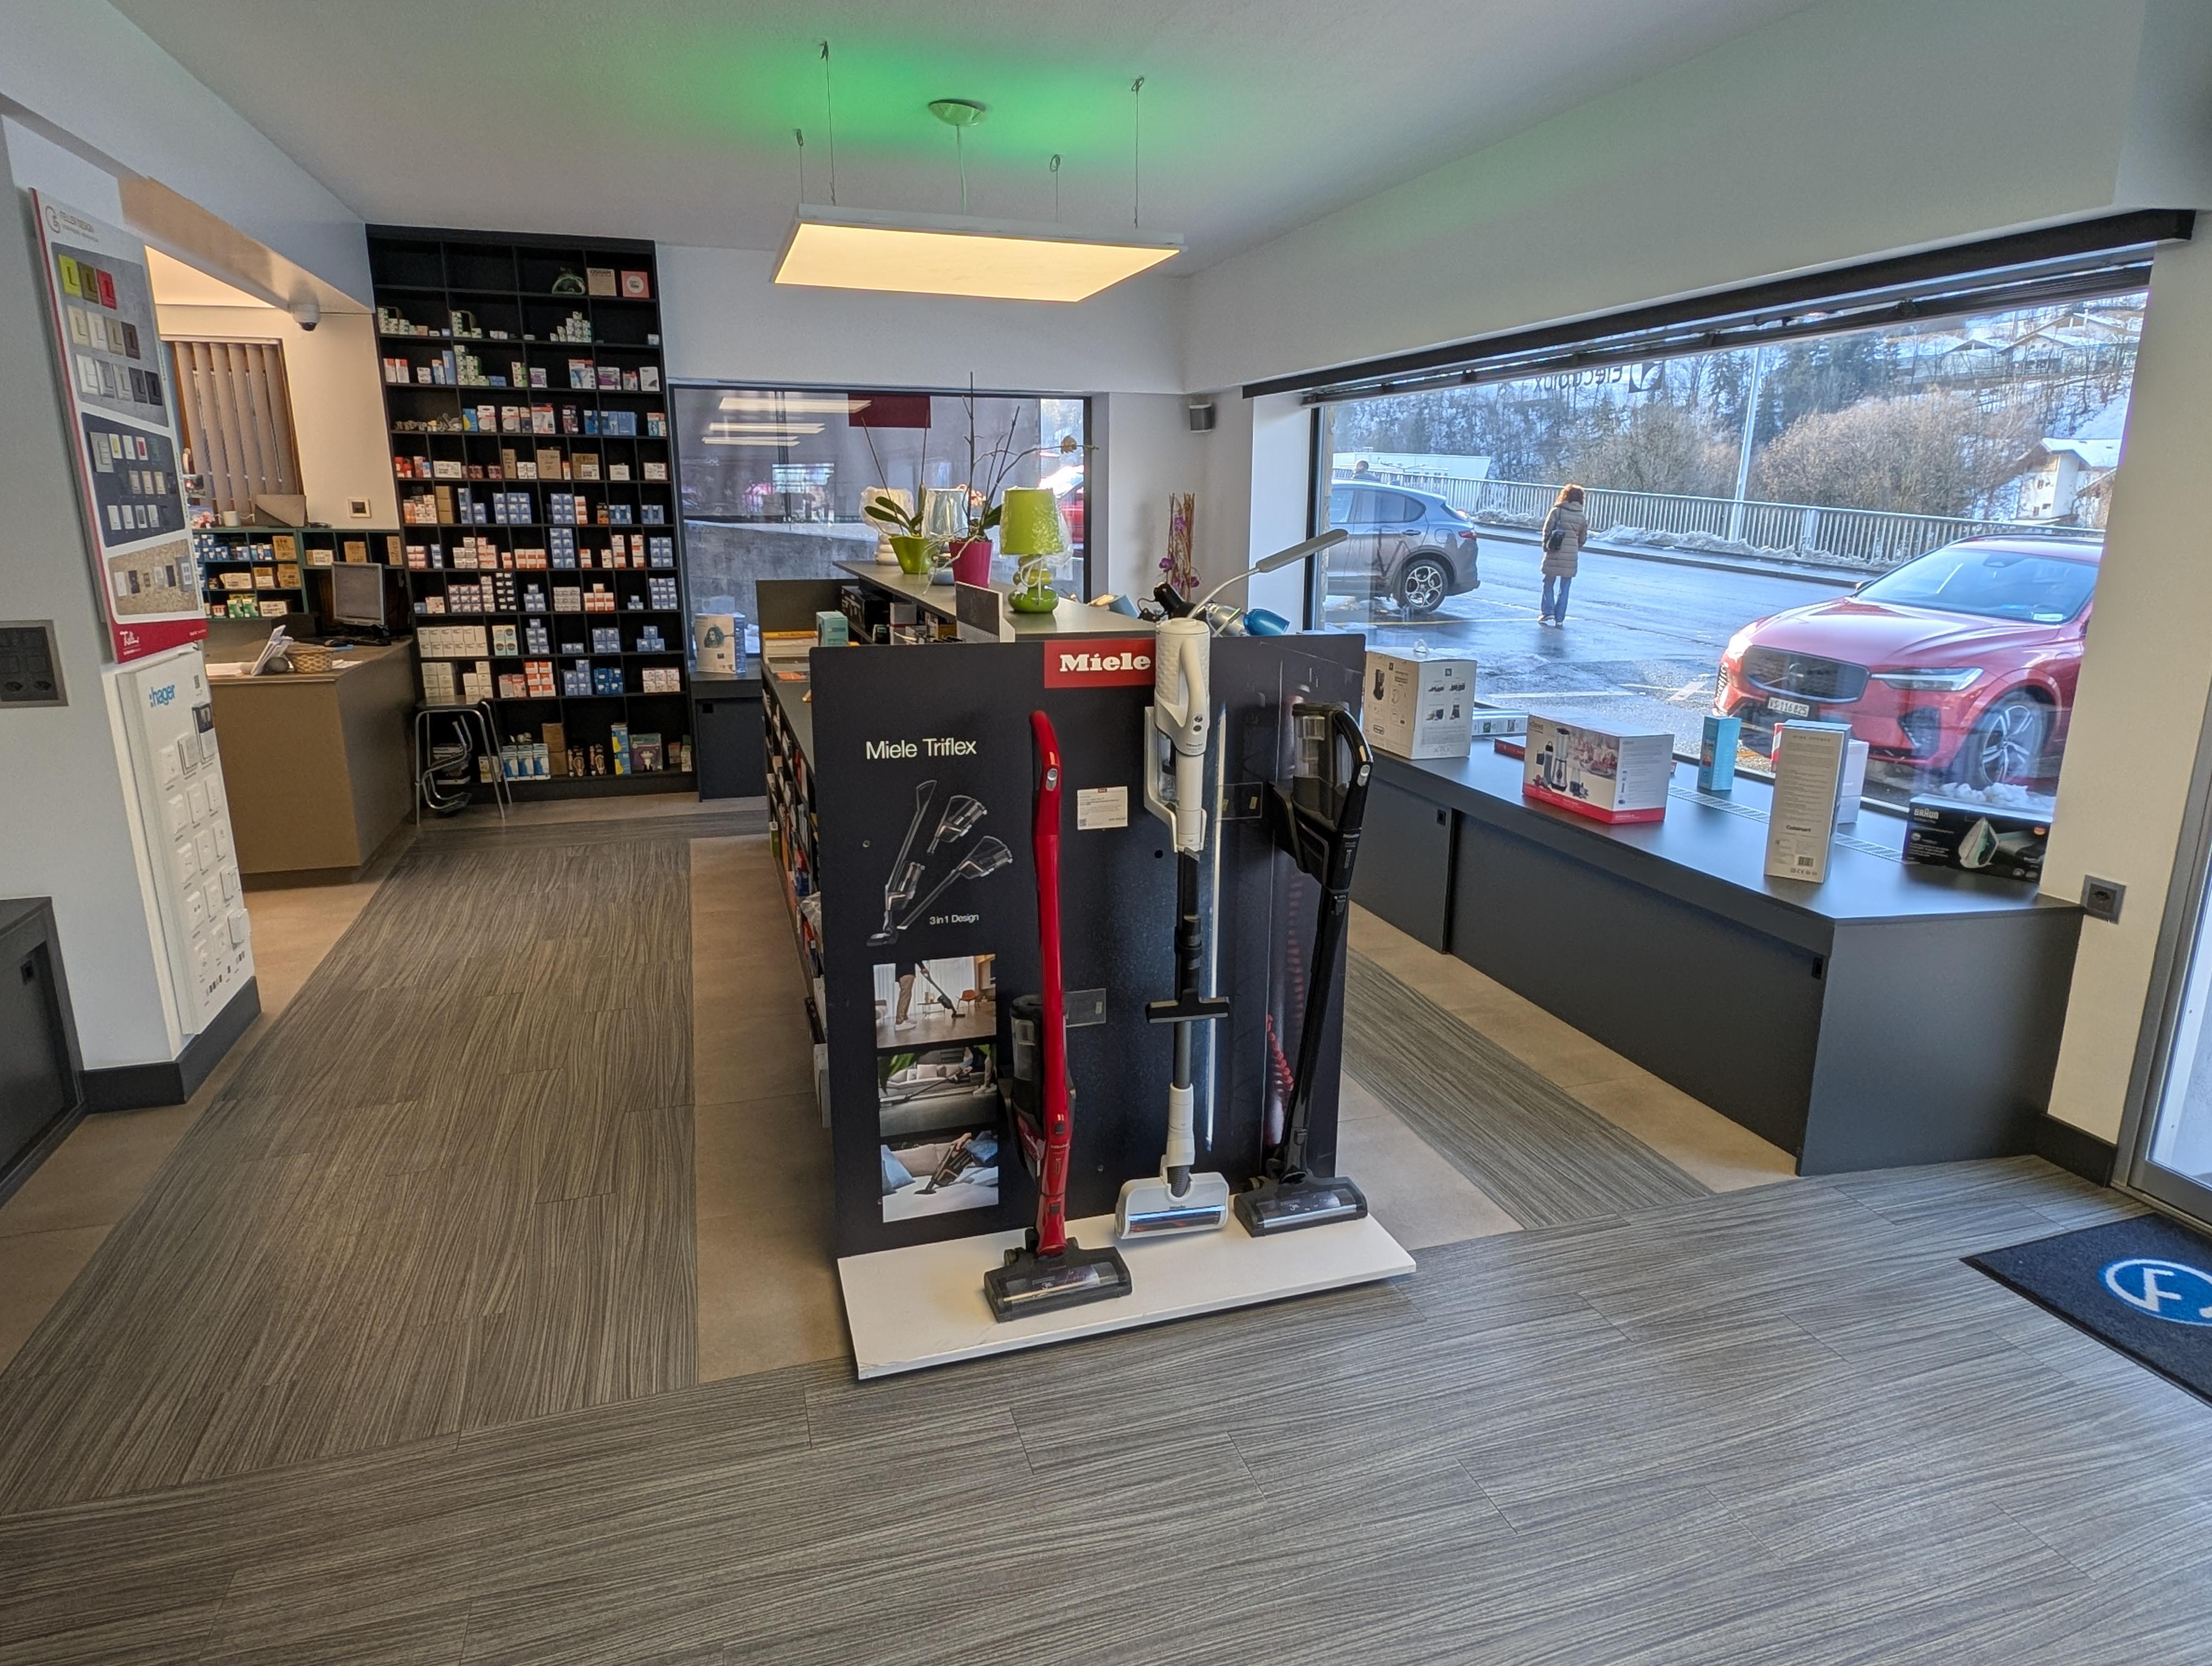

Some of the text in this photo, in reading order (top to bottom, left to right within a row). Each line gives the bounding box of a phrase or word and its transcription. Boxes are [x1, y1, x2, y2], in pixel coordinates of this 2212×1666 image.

[1059, 652, 1151, 672] Miele
[866, 737, 977, 759] Miele Triflex
[1914, 808, 1939, 820] BRAUN
[929, 913, 980, 925] 3 in 1 Design
